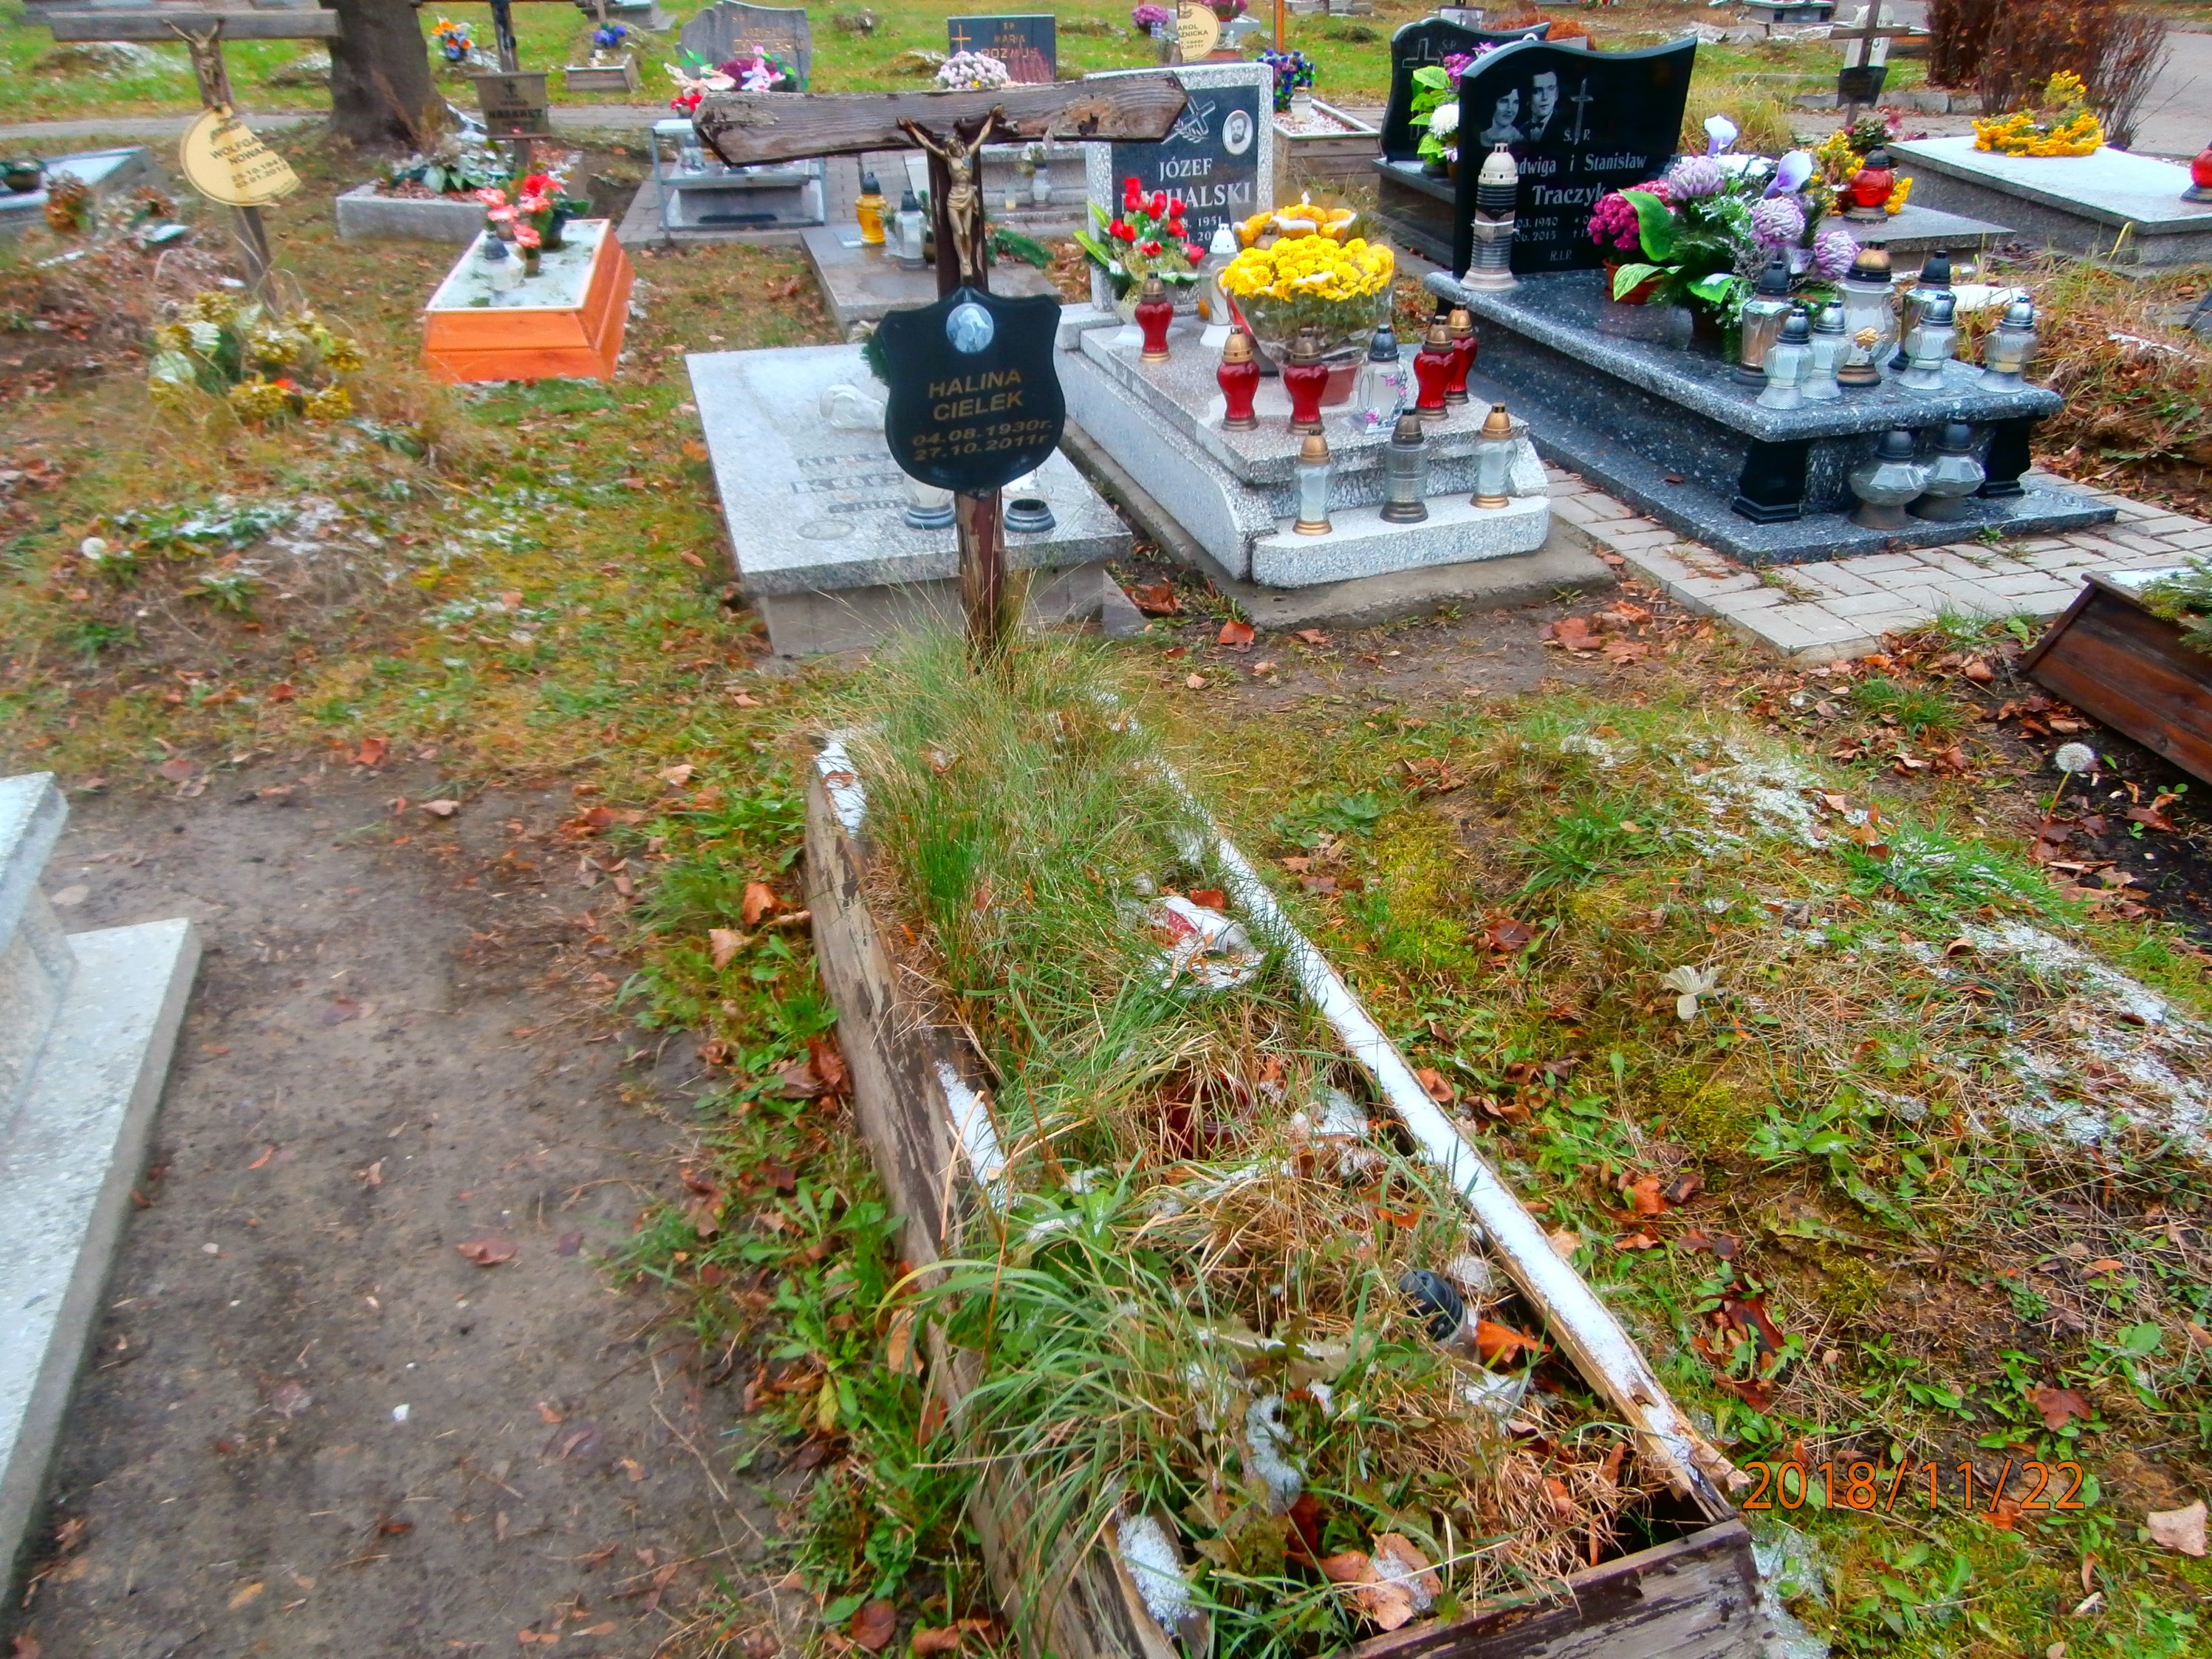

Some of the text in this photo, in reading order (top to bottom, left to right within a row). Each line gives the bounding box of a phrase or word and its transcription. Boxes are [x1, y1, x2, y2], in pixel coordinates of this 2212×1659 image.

[993, 34, 1025, 44] MARIA
[1177, 30, 1208, 38] ZNICKA
[210, 135, 261, 160] WOLFGA
[1159, 155, 1213, 182] JÓZEF
[1569, 154, 1575, 172] i
[1584, 151, 1648, 171] Stanisław
[1531, 182, 1607, 207] Traczyk
[1198, 215, 1222, 228] 1951
[928, 368, 1022, 400] HALINA
[933, 389, 1024, 422] CIELEK
[911, 419, 1053, 447] 04.08.1930r.
